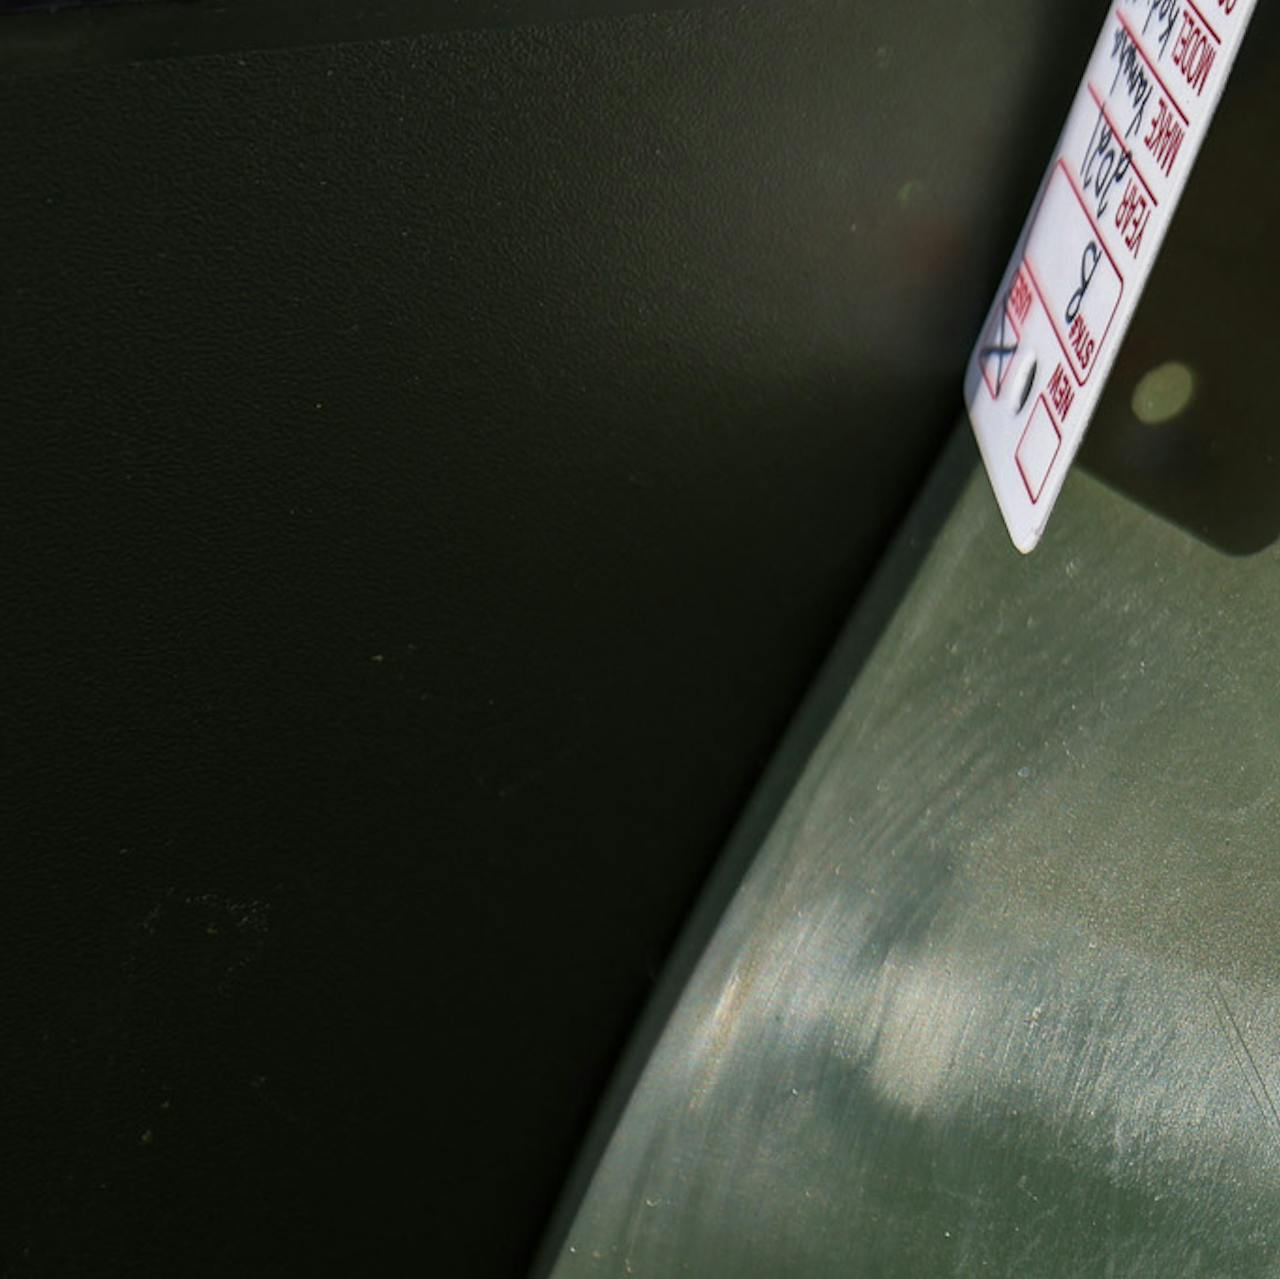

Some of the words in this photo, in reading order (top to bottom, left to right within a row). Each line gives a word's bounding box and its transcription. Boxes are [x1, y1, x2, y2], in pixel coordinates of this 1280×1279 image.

[1172, 11, 1216, 96] MODEL
[1081, 111, 1133, 218] 2021
[1146, 99, 1184, 176] MAKE
[1116, 180, 1151, 259] YEAR
[1070, 314, 1095, 370] STK#
[1049, 364, 1075, 422] NEW
